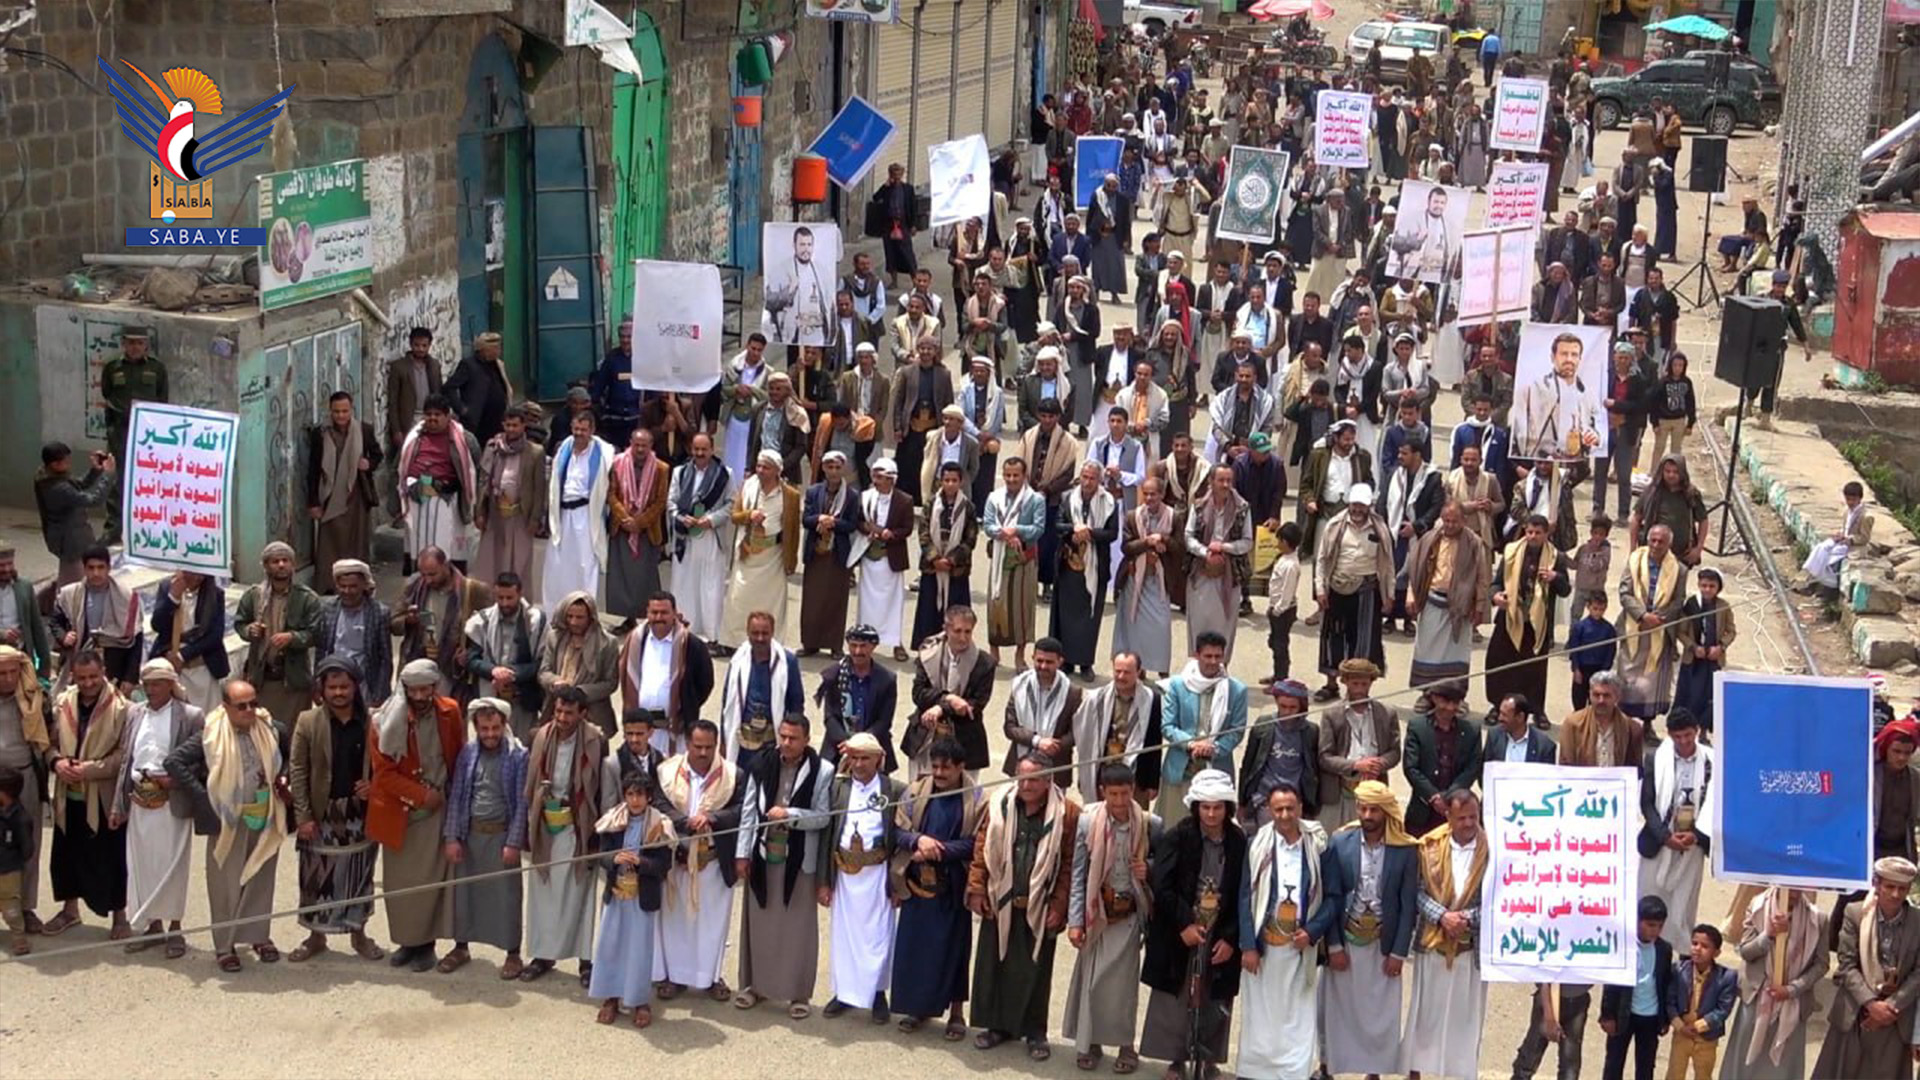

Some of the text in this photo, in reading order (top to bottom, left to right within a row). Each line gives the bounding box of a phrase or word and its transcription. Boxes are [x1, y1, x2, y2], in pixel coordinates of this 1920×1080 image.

[138, 419, 192, 450] أكبر
[192, 426, 227, 451] الله
[136, 451, 223, 479] الموت لأمريكا
[183, 487, 221, 504] الموت
[133, 505, 221, 529] اللعنة على اليهود
[133, 527, 221, 557] النصر للإسلام
[1503, 784, 1618, 826] الله أكبر
[1504, 828, 1617, 857] الموت لأمريكا
[1503, 863, 1617, 888] الموت لإسرائيل
[1501, 895, 1617, 919] اللعنة على اليهود
[1500, 926, 1618, 962] النصر للإسلام
